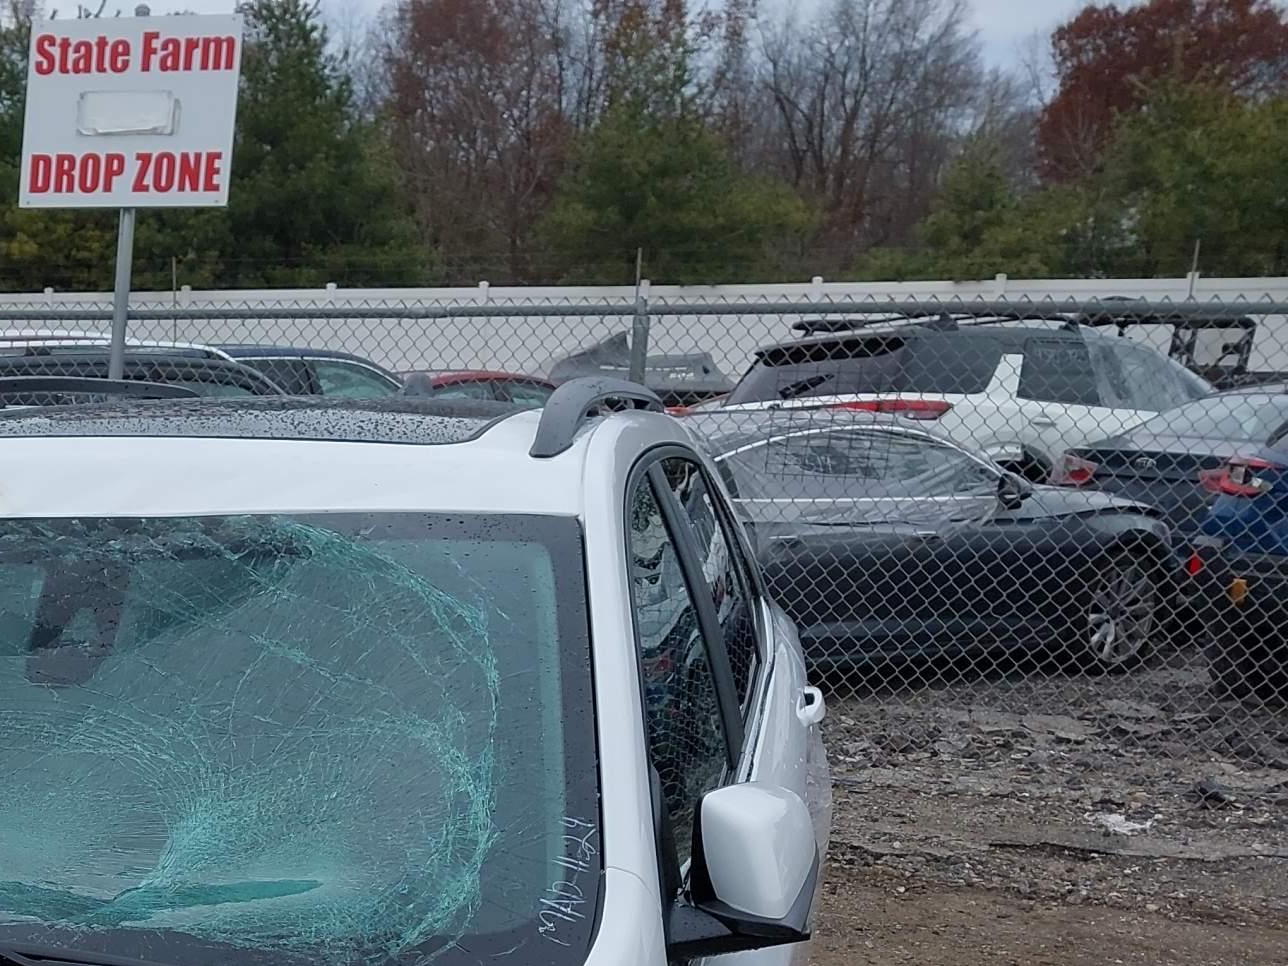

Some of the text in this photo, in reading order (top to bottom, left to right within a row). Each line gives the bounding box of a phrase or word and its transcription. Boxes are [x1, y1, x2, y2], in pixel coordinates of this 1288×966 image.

[34, 31, 236, 75] State Farm
[28, 151, 223, 194] DROP ZONE
